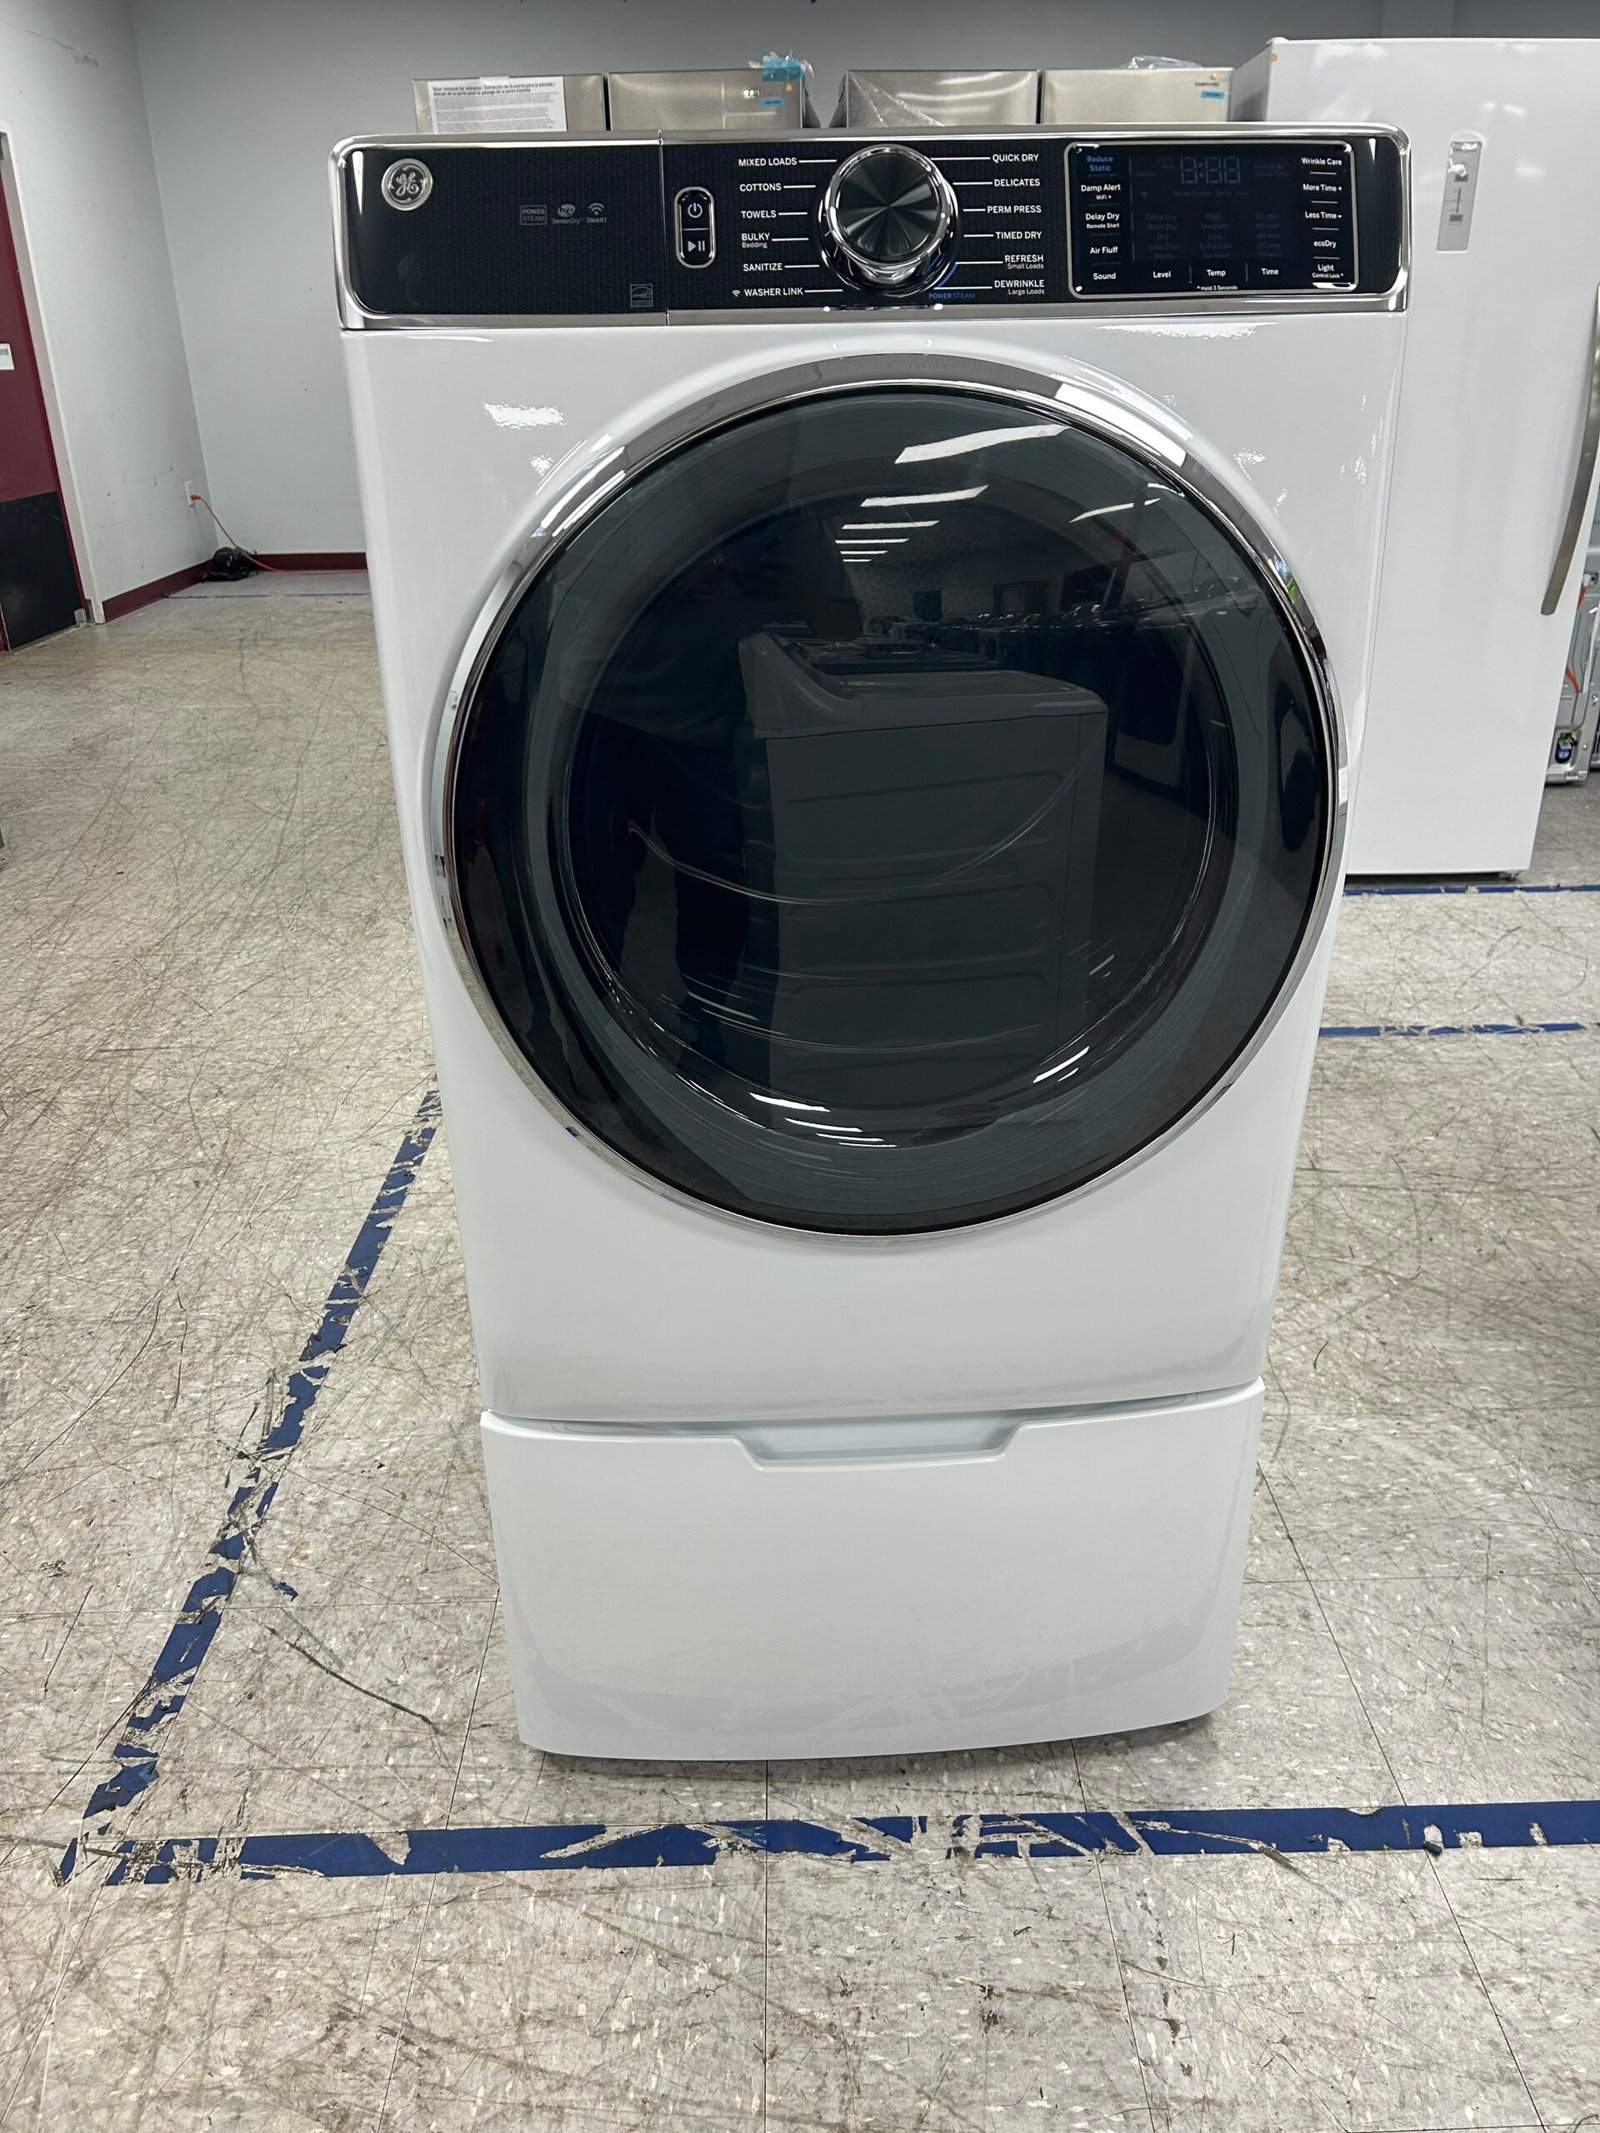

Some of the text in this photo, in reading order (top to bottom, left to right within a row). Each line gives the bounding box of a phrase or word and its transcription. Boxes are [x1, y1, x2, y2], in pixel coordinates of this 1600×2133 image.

[738, 157, 798, 167] MIXED LOADS
[992, 153, 1039, 164] QUICK DRY
[1086, 155, 1114, 163] Reduce
[1301, 157, 1343, 166] Wrinkle Care
[1089, 164, 1112, 172] Static
[739, 182, 782, 192] COTTONS
[994, 178, 1041, 187] DELICATES
[1080, 183, 1122, 193] Damp Alert
[1302, 183, 1320, 192] More
[1320, 183, 1337, 192] Time
[987, 204, 1042, 214] PERM PRESS
[740, 209, 777, 219] TOWELS
[1085, 212, 1120, 222] Delay Dry
[1304, 211, 1320, 219] Less
[1320, 211, 1337, 219] Time
[741, 232, 771, 241] BULKY
[995, 230, 1043, 240] TIMED DRY
[741, 241, 768, 249] Bedding
[1313, 239, 1337, 249] ecoDry
[1089, 245, 1119, 254] Air Fluff
[1004, 254, 1044, 263] REFRESH
[742, 262, 783, 272] SANITIZE
[1007, 262, 1045, 270] Small Loads
[1317, 263, 1335, 273] Light
[1152, 270, 1172, 279] Level
[1206, 269, 1227, 278] Temp
[1261, 267, 1279, 276] Time
[1092, 272, 1117, 281] Sound
[994, 279, 1045, 288] DEWRINKLE
[743, 287, 804, 297] WASHER LINK
[1008, 288, 1026, 296] Large
